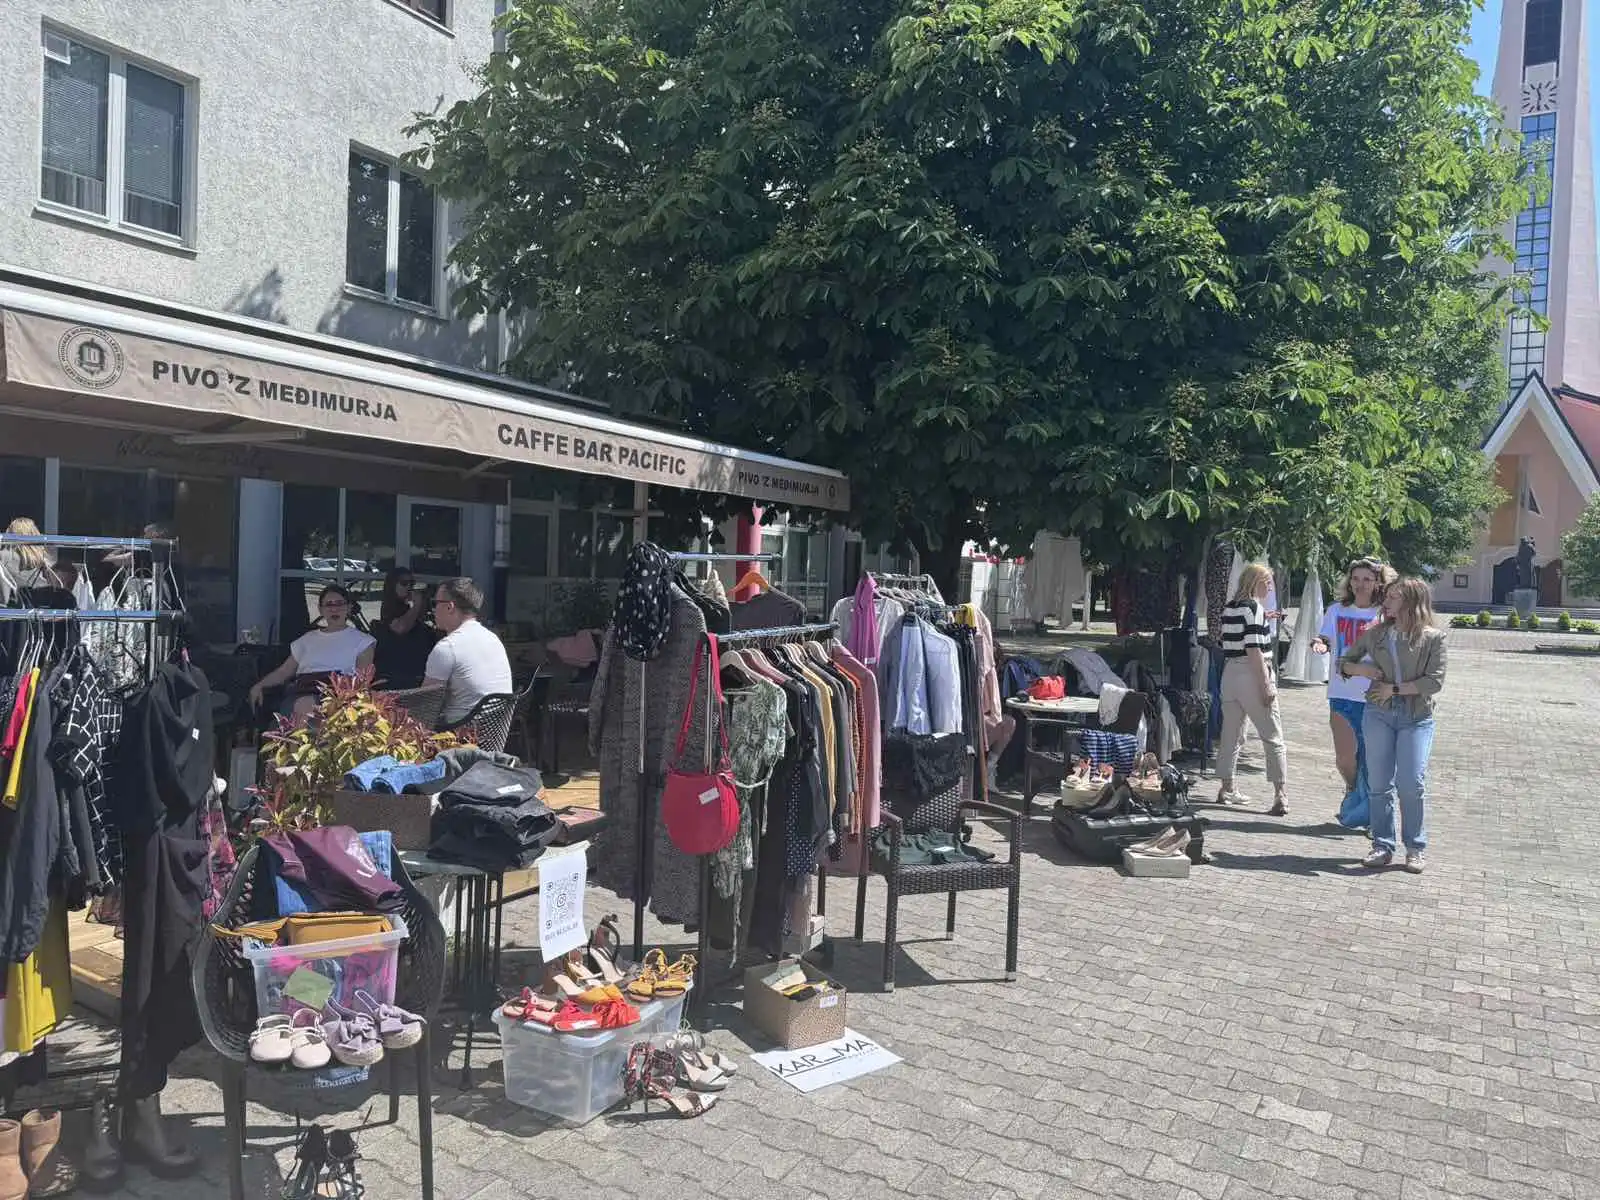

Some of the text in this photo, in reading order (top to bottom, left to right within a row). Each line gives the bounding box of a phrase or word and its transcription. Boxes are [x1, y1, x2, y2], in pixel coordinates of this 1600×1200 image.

[152, 359, 220, 390] PIVO
[259, 380, 398, 422] MEĐIMURJA
[497, 423, 686, 476] CAFFE BAR PACIFIC
[738, 471, 760, 486] PIVO
